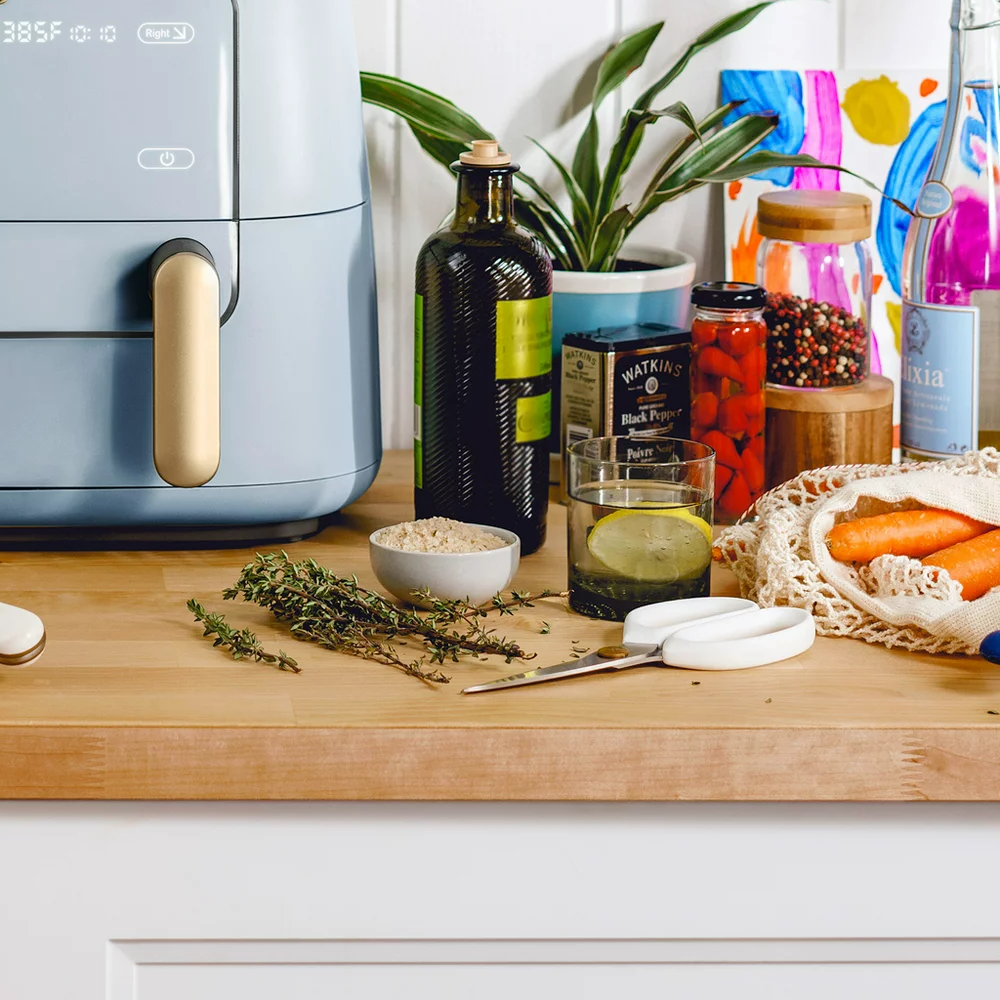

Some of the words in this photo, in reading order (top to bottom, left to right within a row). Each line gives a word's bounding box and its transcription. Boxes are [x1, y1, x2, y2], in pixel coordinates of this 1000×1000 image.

[3, 21, 63, 43] 385F
[145, 28, 170, 40] Right
[621, 358, 683, 385] WATKINS
[621, 411, 648, 426] Black
[649, 408, 683, 423] Pepper
